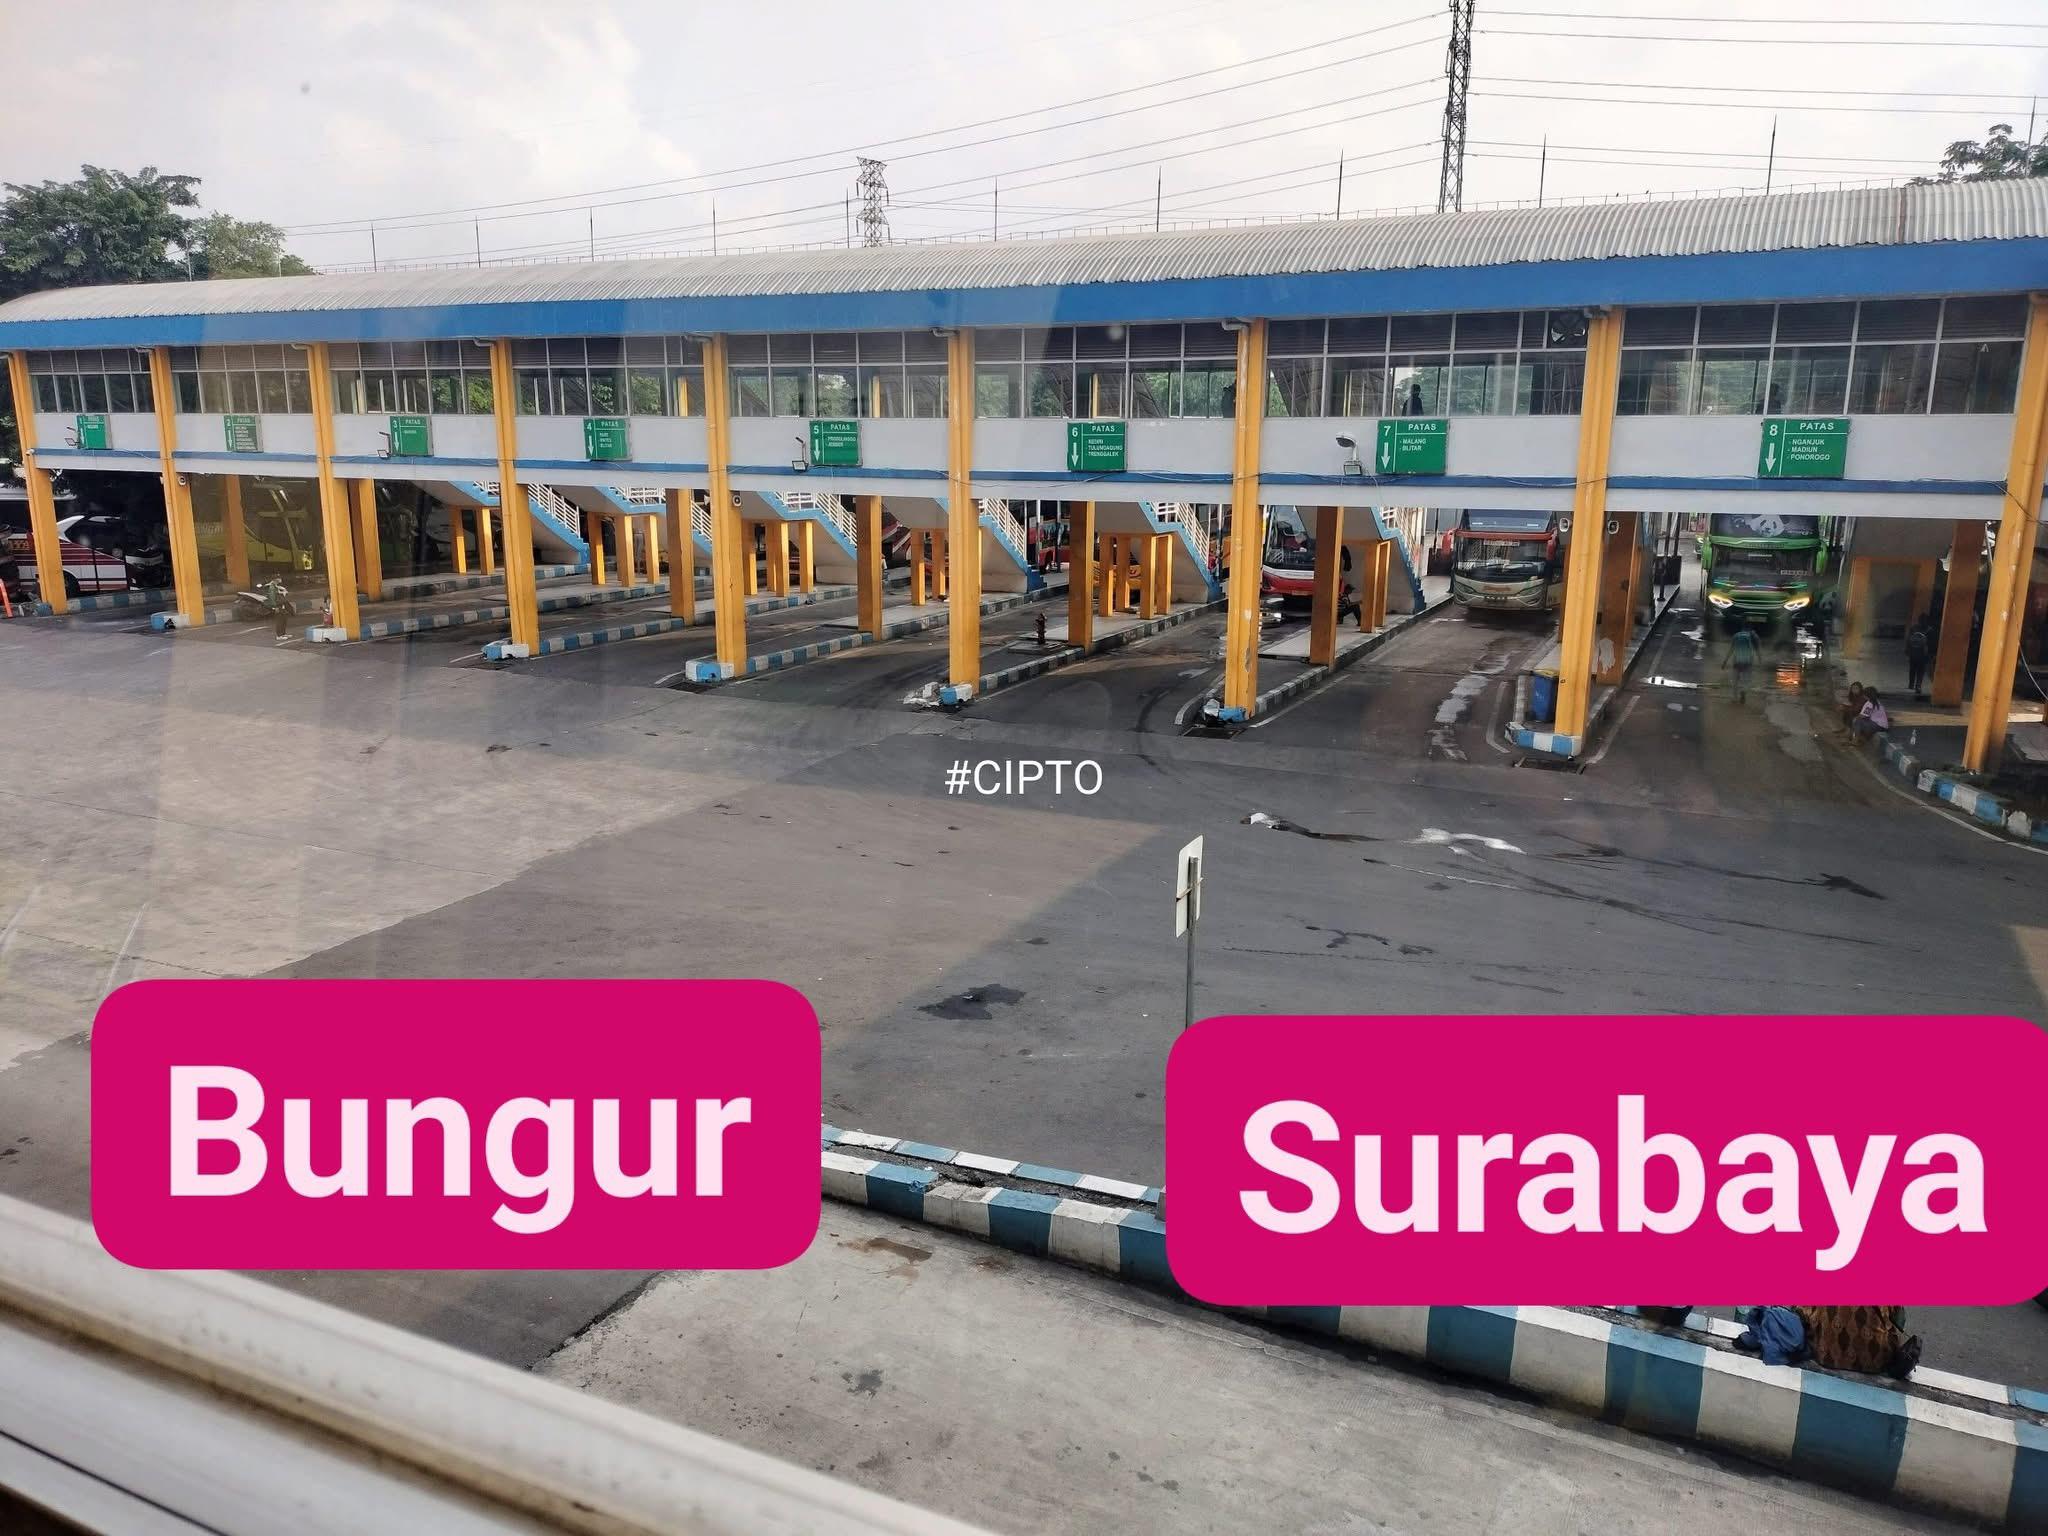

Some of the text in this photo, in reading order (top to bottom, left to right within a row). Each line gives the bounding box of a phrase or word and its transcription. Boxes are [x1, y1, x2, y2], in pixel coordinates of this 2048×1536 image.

[226, 418, 231, 426] 2
[392, 420, 397, 428] 3
[586, 422, 592, 430] 4
[1800, 422, 1834, 430] PATAS
[813, 425, 819, 434] 5
[1384, 425, 1391, 436] 7
[1408, 423, 1437, 431] PATAS
[1769, 424, 1778, 436] 8
[1072, 427, 1078, 437] 6
[1790, 453, 1831, 461] PONOROGO
